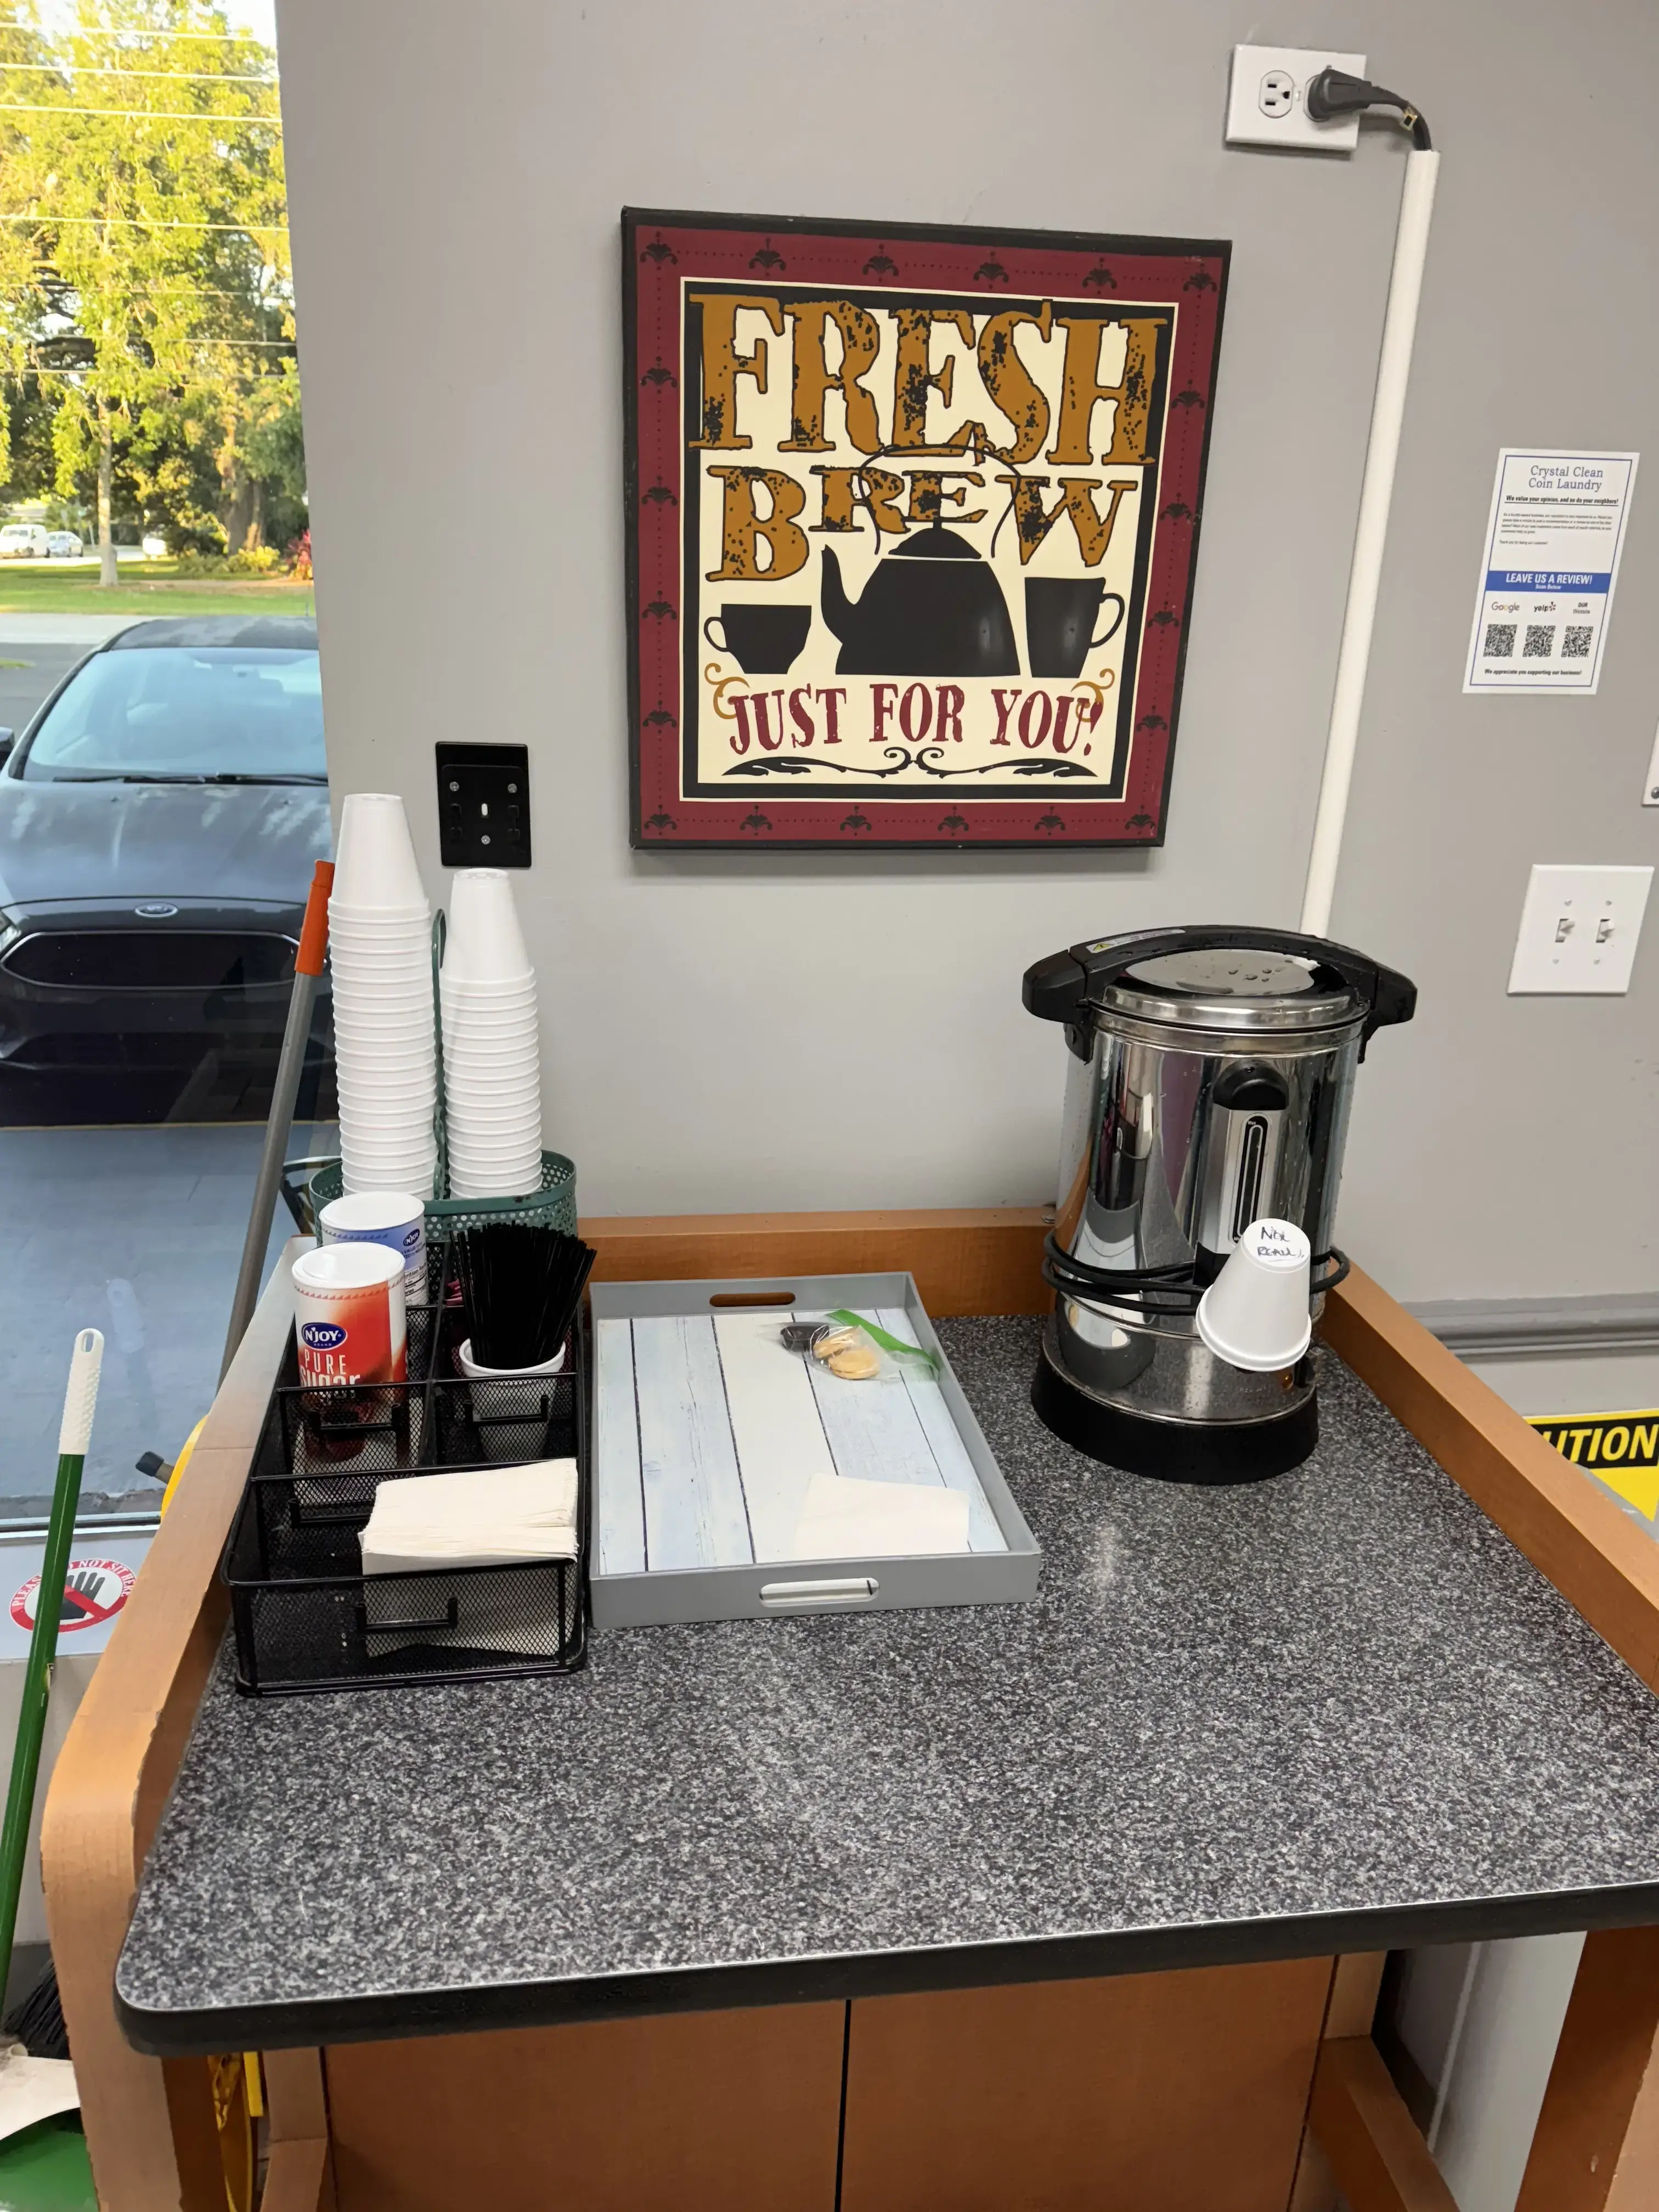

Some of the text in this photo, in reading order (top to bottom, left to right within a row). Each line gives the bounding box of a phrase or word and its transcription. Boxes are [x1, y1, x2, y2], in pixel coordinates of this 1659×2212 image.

[689, 293, 1169, 466] FRESH
[1531, 465, 1603, 478] Crystal Clean
[1528, 477, 1602, 493] Coin Laundry
[706, 465, 1138, 582] BREW
[1506, 573, 1593, 584] LEAVE US A REVIEW!
[1491, 601, 1520, 613] Google
[1533, 604, 1548, 612] yelp
[727, 682, 1103, 756] JUST FOR YOU!
[304, 1348, 347, 1375] PURE
[12, 1575, 42, 1606] PLEAS
[78, 1560, 109, 1568] NOT
[108, 1562, 129, 1575] SIT
